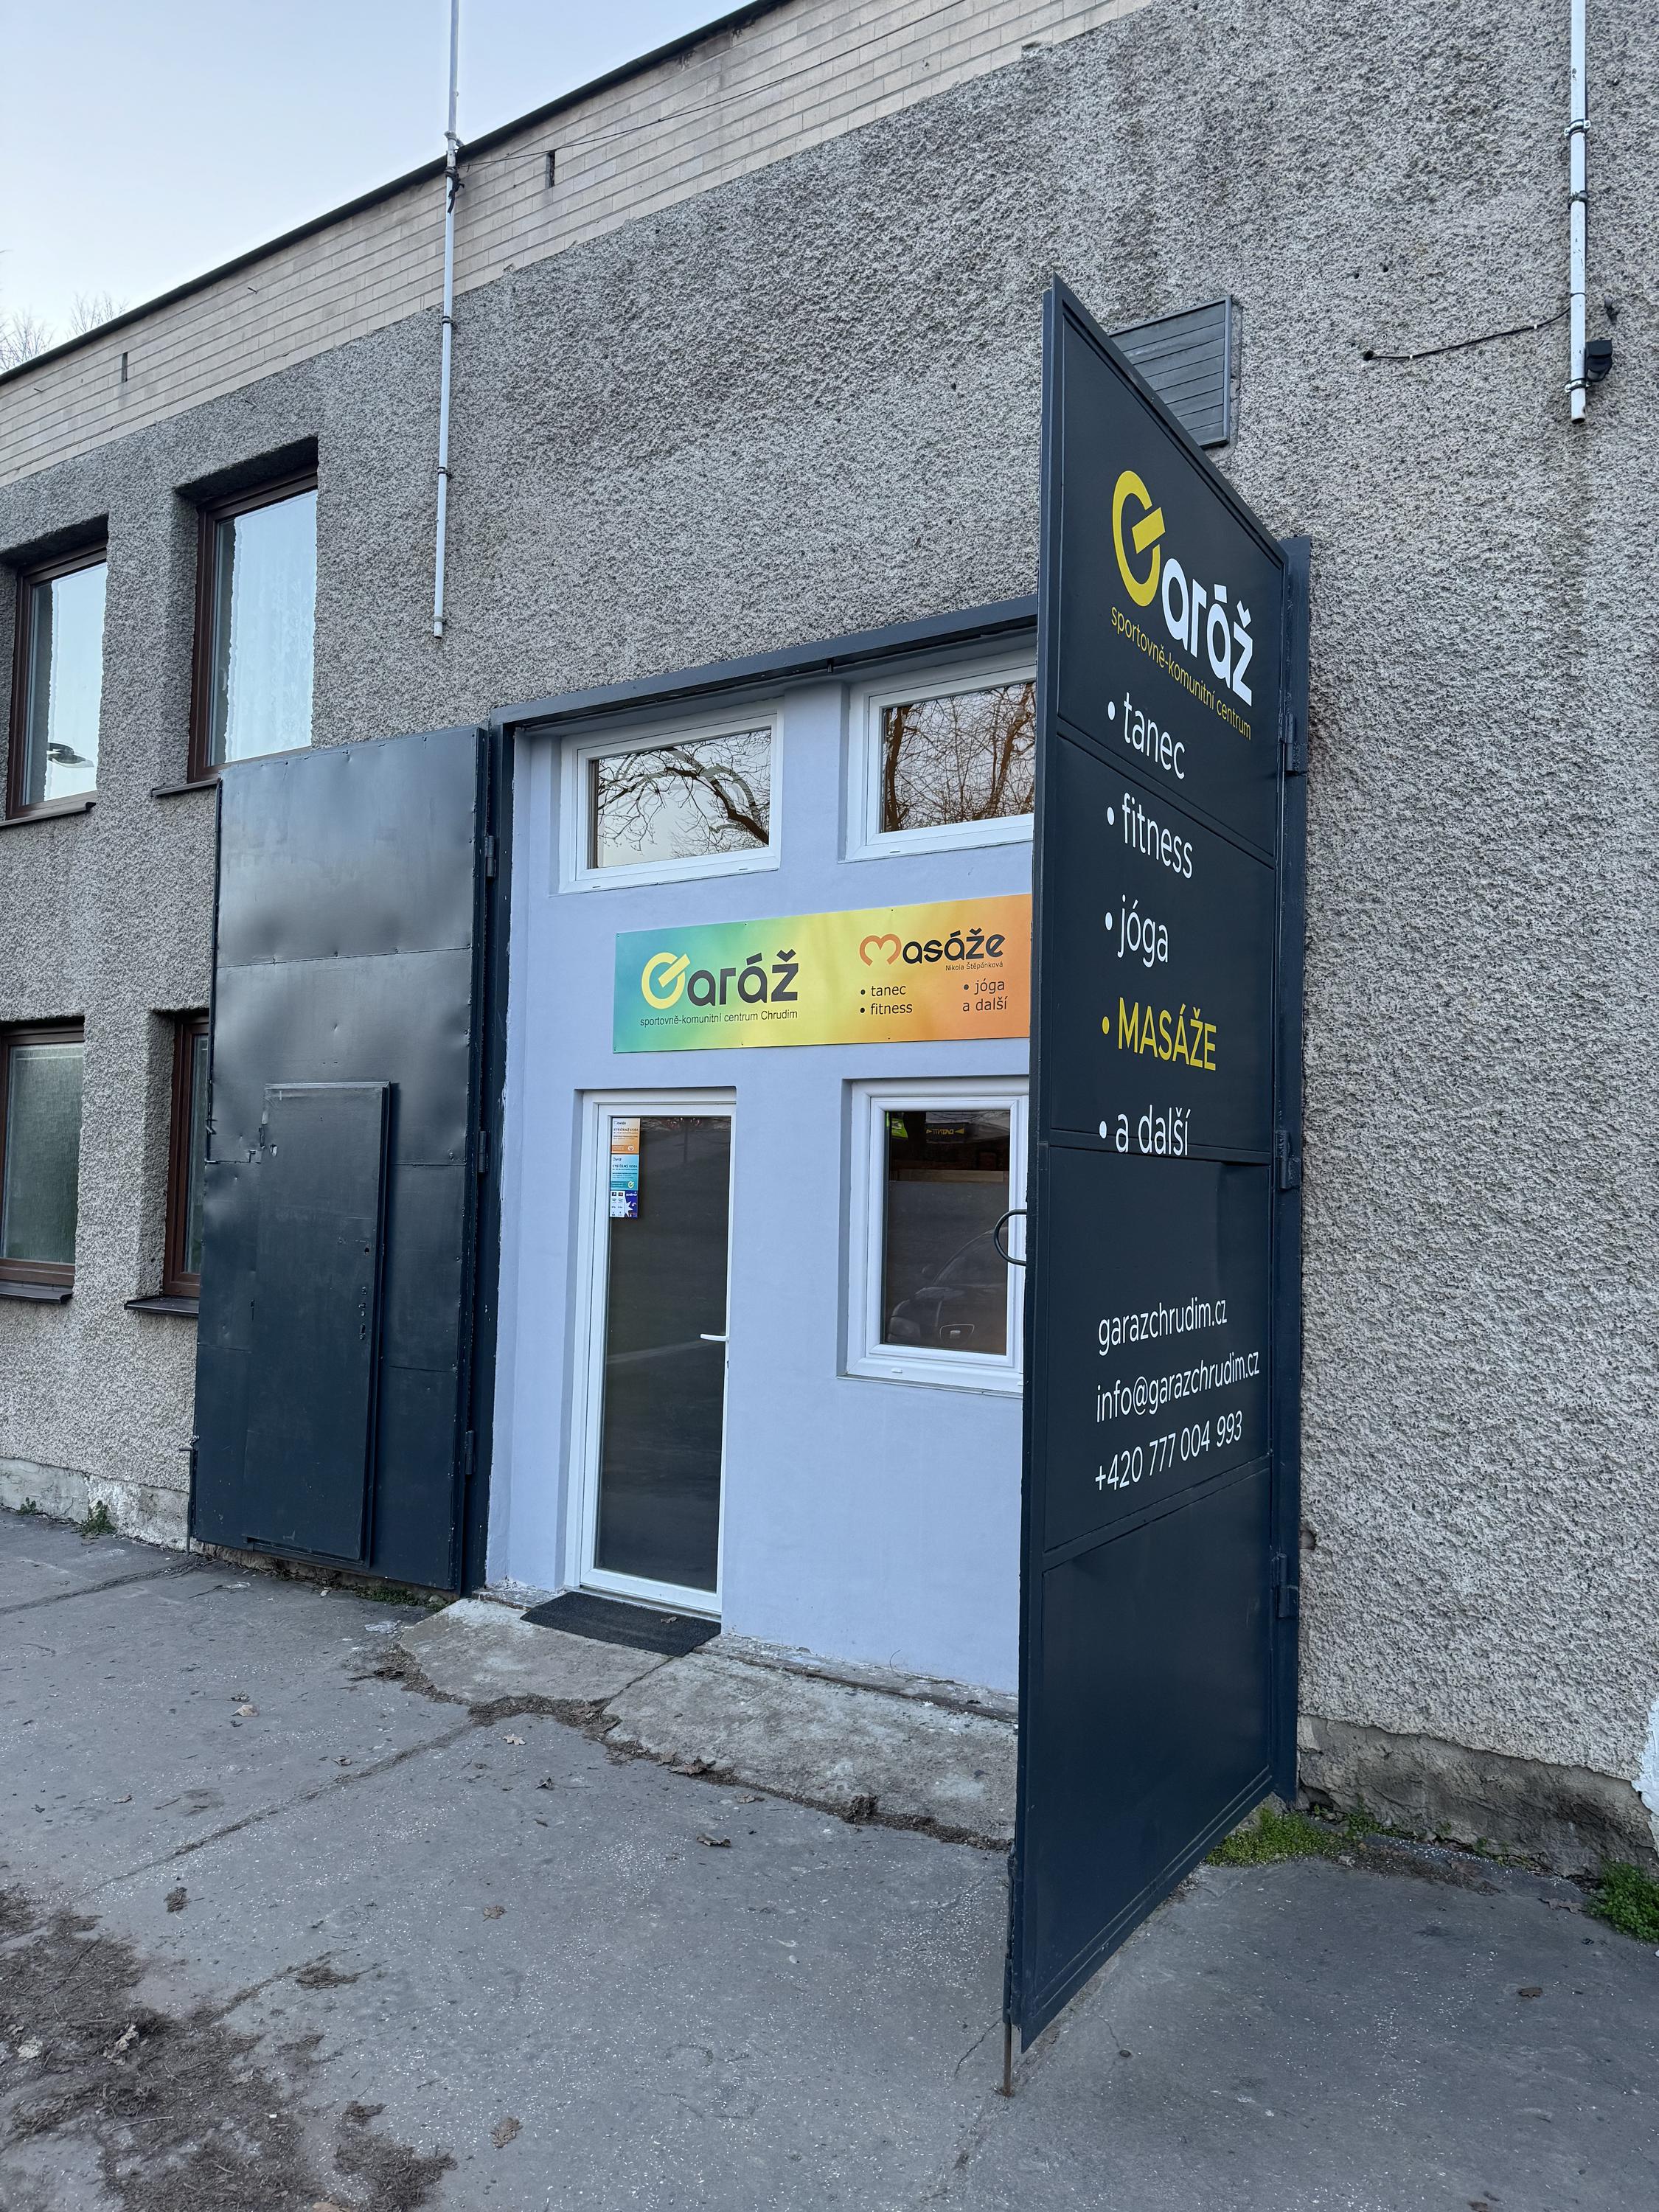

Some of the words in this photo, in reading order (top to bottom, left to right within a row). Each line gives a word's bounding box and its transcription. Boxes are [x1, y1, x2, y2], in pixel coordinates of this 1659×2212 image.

[1112, 470, 1253, 707] Garáž
[1110, 606, 1216, 711] sportovně-komunitní
[1216, 699, 1251, 741] centrum
[1123, 692, 1186, 779] tanec
[1121, 792, 1193, 879] fitness
[1117, 894, 1169, 968] jóga
[641, 948, 799, 1009] Garáž
[871, 985, 907, 997] tanec
[966, 960, 1004, 970] Štěpánková
[974, 978, 1005, 995] jóga
[640, 1012, 721, 1028] sportovně-komunitní
[724, 1012, 758, 1022] centrum
[760, 1009, 798, 1020] Chrudim
[870, 1003, 913, 1015] fitness
[962, 1002, 970, 1012] a
[975, 996, 1008, 1011] další
[1118, 996, 1217, 1071] MASÁŽE
[1115, 1113, 1129, 1153] a
[1138, 1105, 1192, 1156] další
[1098, 1296, 1228, 1356] garazchrudim.cz
[1096, 1352, 1260, 1423] info@garazchrudim.cz
[1095, 1446, 1143, 1491] +420
[1149, 1433, 1177, 1476] 777
[1180, 1420, 1211, 1461] 004
[1216, 1410, 1243, 1447] 993
